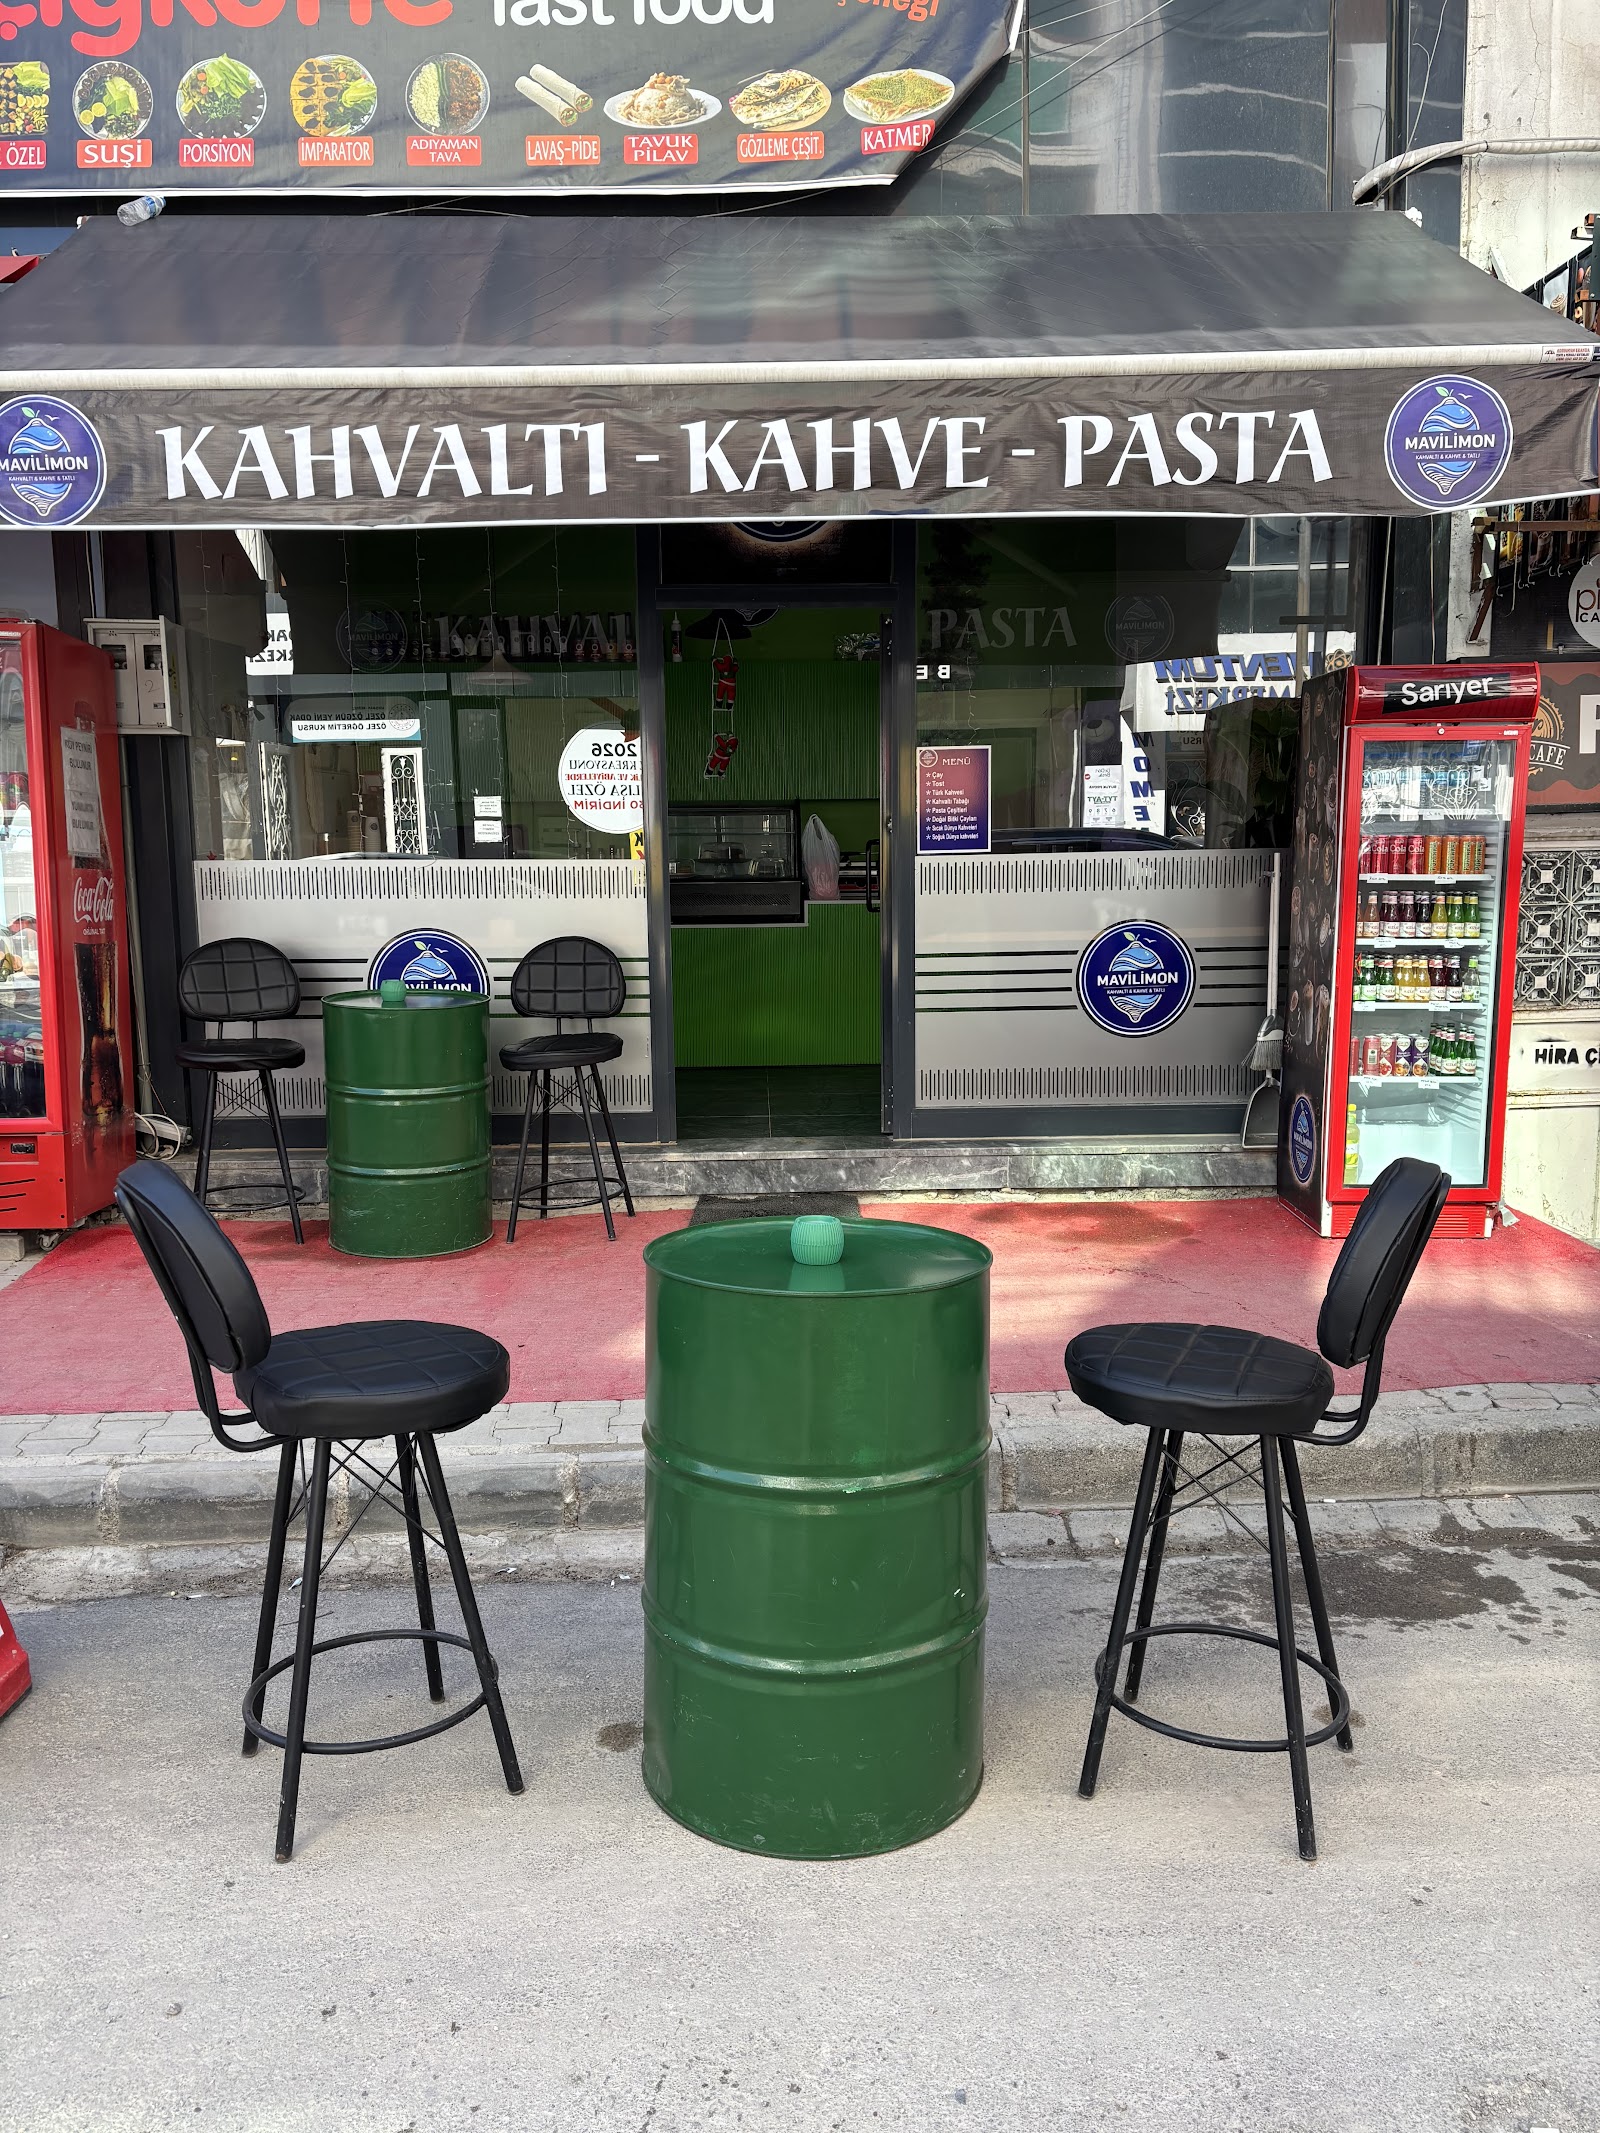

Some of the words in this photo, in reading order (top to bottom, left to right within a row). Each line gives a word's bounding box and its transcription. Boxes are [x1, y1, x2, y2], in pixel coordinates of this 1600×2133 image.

[411, 139, 478, 151] ADIYAMAN
[627, 135, 694, 149] TAVUK
[740, 136, 789, 158] GÖZLEME
[863, 124, 931, 150] KATMER
[5, 139, 45, 166] ÖZEL
[84, 140, 143, 168] SUŞİ
[182, 139, 252, 164] PORSİYON
[301, 138, 371, 162] İMPARATOR
[429, 150, 462, 163] TAVA
[527, 138, 599, 163] LAVAŞ-PİDE
[633, 146, 688, 164] PİLAV
[1405, 433, 1496, 450] MAVİLİMON
[155, 421, 608, 501] KAHVALTI
[680, 415, 989, 495] KAHVE
[1057, 408, 1333, 488] PASTA
[927, 607, 1078, 650] PASTA
[1401, 676, 1493, 706] Sarıyer
[942, 756, 971, 766] MENÜ
[1529, 744, 1566, 766] CAFE
[932, 771, 944, 779] Çay
[947, 806, 968, 814] Çeşitleri
[953, 798, 970, 806] Tabağı
[932, 833, 945, 841] Soğuk
[946, 833, 959, 841] Dünya
[1097, 971, 1179, 987] MAVİLİMON
[1535, 1044, 1579, 1064] HİRA
